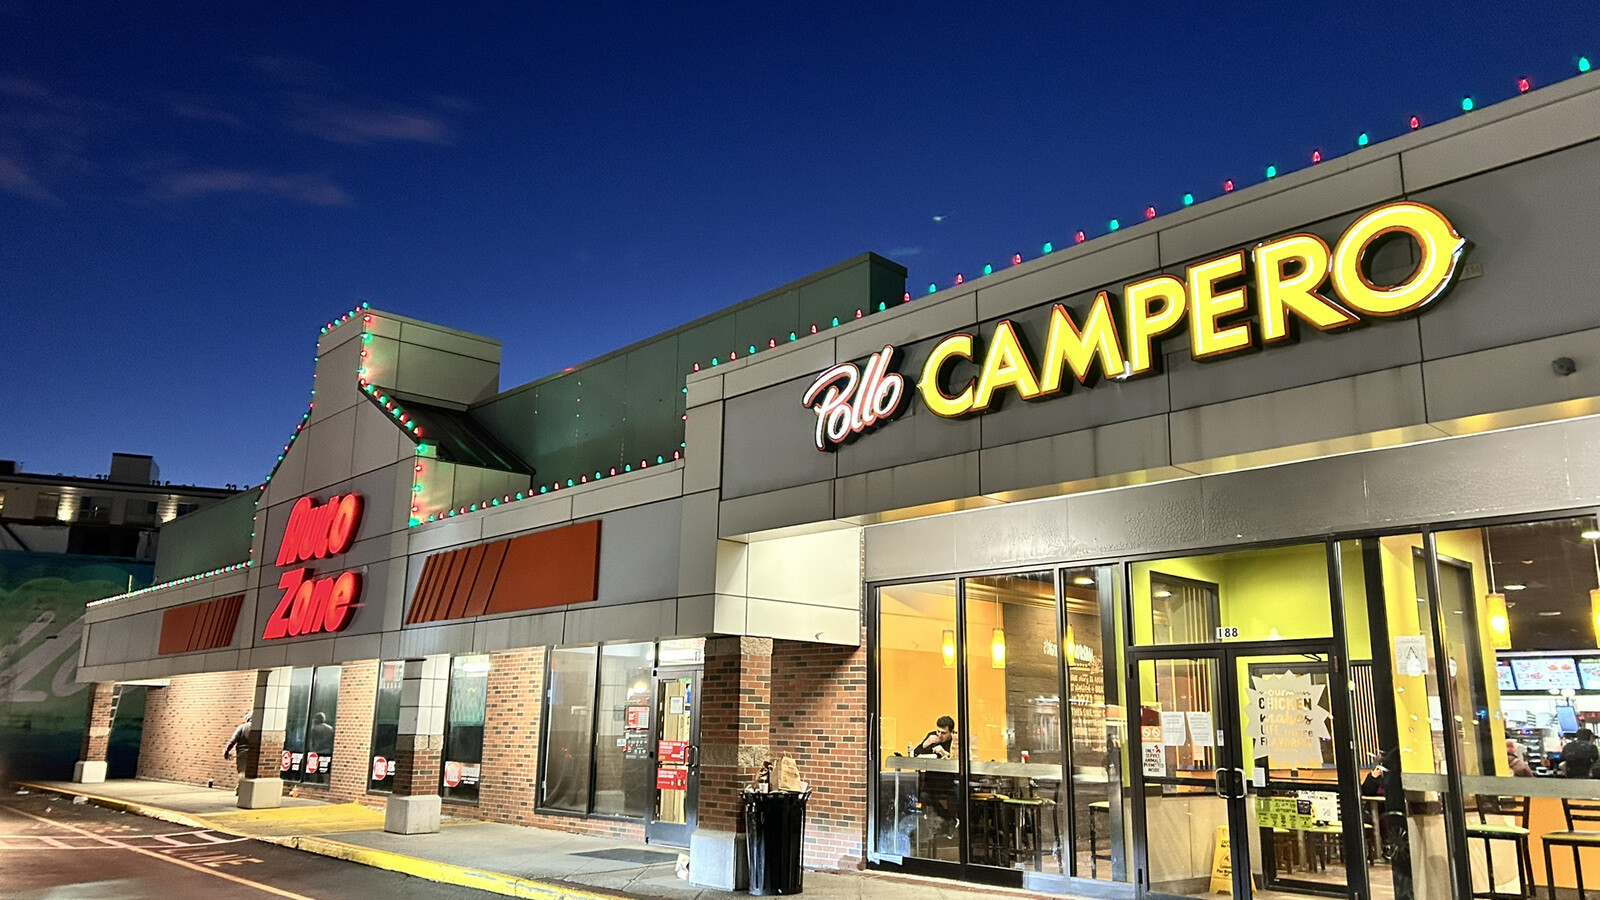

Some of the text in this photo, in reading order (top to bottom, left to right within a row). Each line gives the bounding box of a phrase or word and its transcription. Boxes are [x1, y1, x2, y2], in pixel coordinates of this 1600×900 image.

[803, 201, 1466, 451] Pollo CAMPERO
[276, 493, 363, 567] Auto
[263, 568, 362, 640] Zone
[1218, 628, 1238, 638] 188
[1267, 688, 1286, 697] our
[1258, 697, 1312, 711] CHICKEN
[1260, 711, 1314, 726] makes
